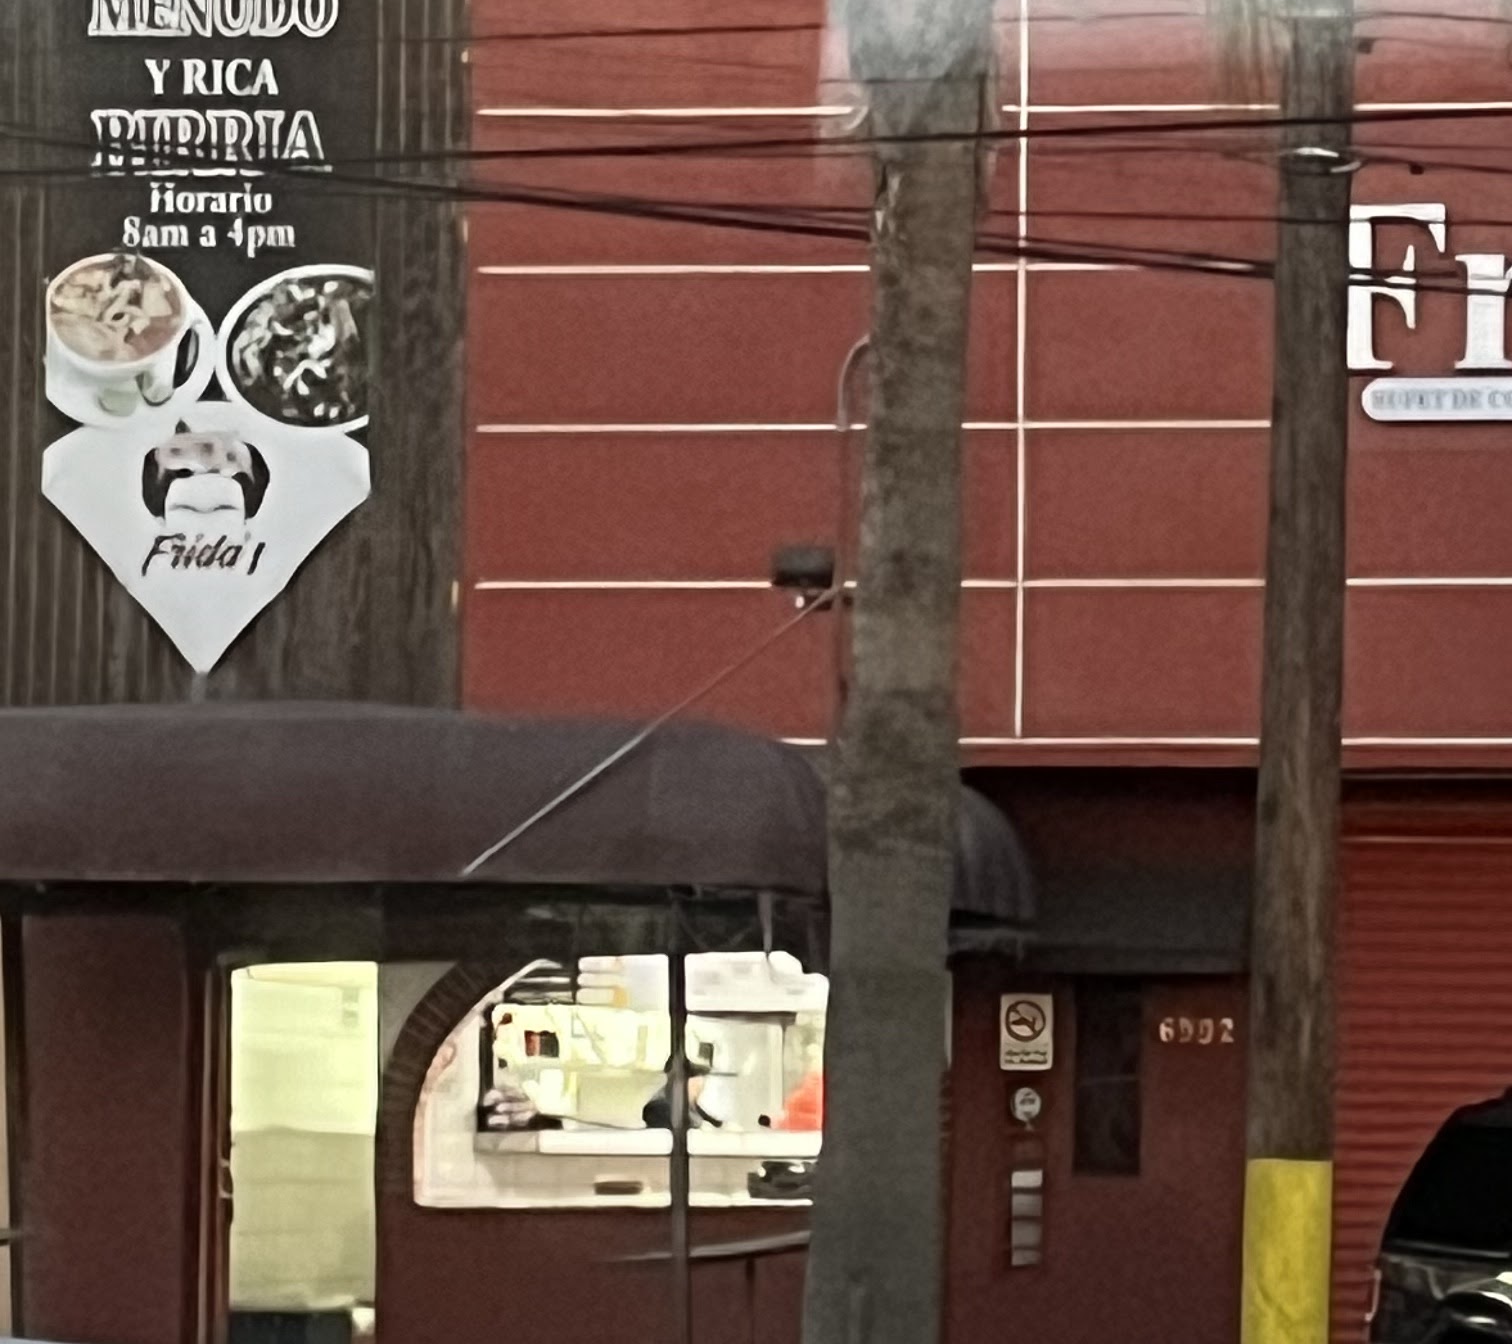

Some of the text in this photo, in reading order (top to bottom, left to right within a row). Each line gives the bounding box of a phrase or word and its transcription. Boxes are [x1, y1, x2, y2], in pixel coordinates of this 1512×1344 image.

[144, 58, 279, 96] Y RICA
[149, 181, 273, 214] Horario
[122, 215, 296, 258] 8am a 4pm
